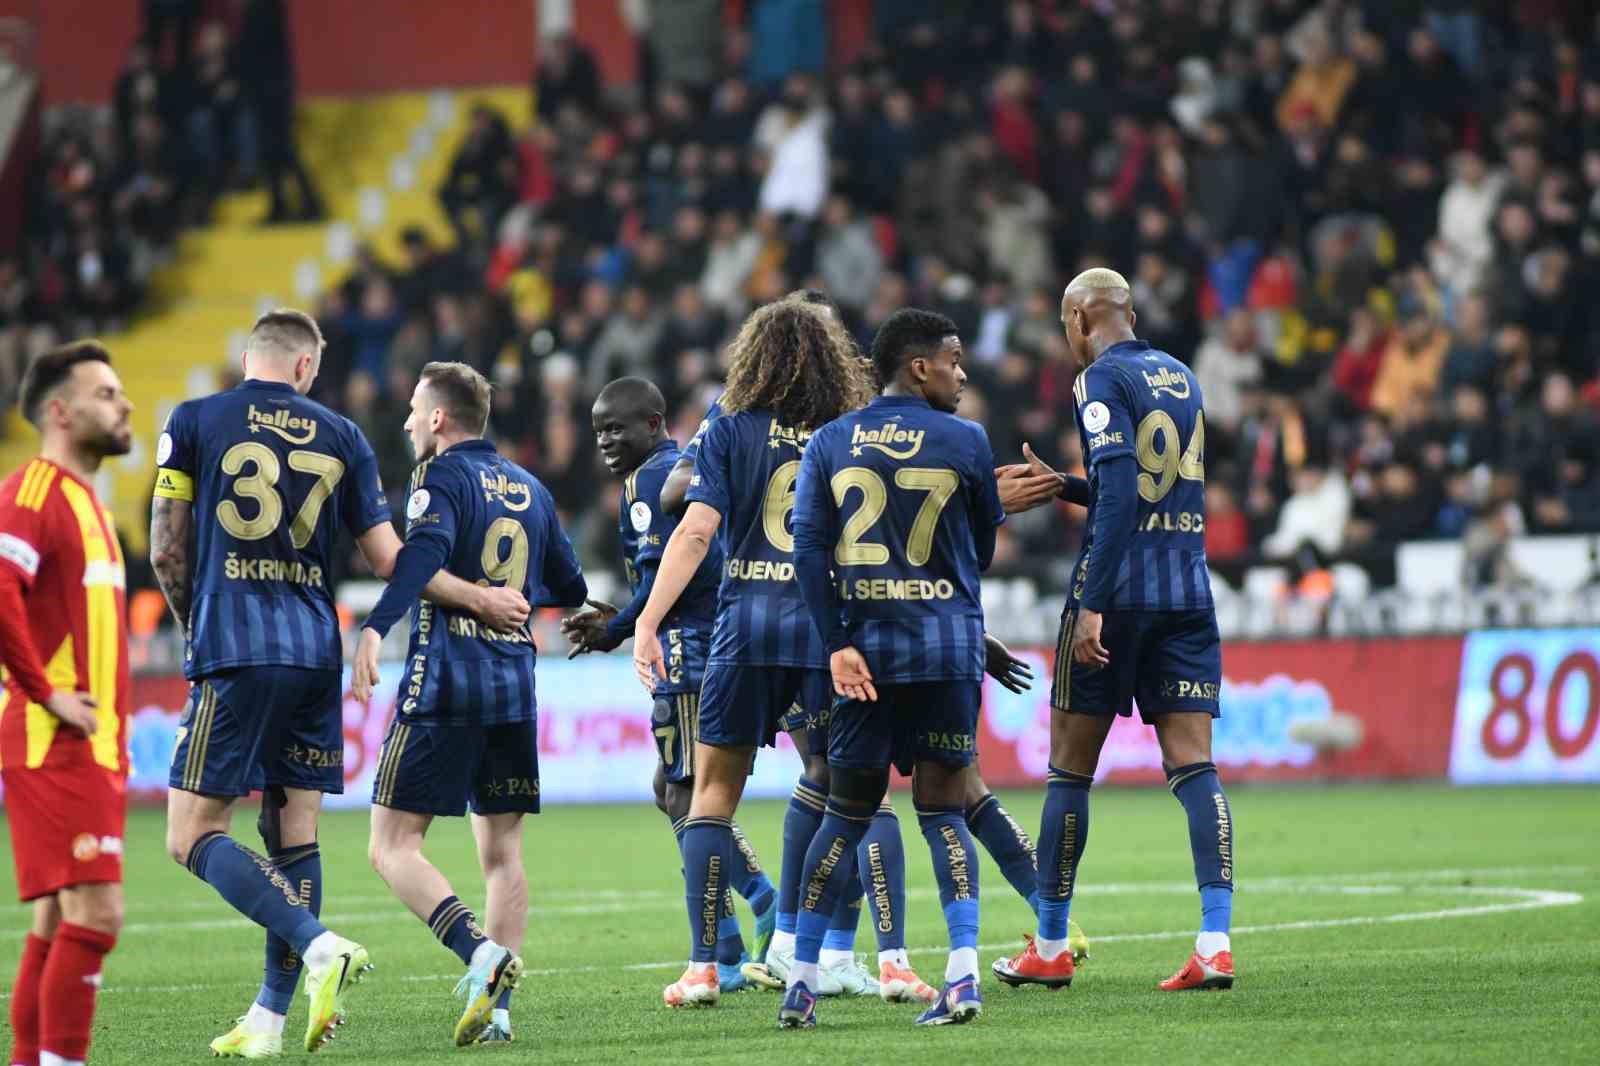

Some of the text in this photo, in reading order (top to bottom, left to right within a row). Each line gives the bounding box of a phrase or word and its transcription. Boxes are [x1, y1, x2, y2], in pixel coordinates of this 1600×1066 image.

[1142, 367, 1191, 399] halley
[248, 404, 316, 444] halley
[851, 423, 925, 459] halley
[1136, 409, 1205, 503] 94
[216, 442, 345, 549] 37
[830, 467, 959, 566] 27
[476, 517, 528, 592] 9
[728, 559, 798, 581] GUEND
[855, 579, 954, 600] SEMEDO
[1481, 653, 1600, 761] 80
